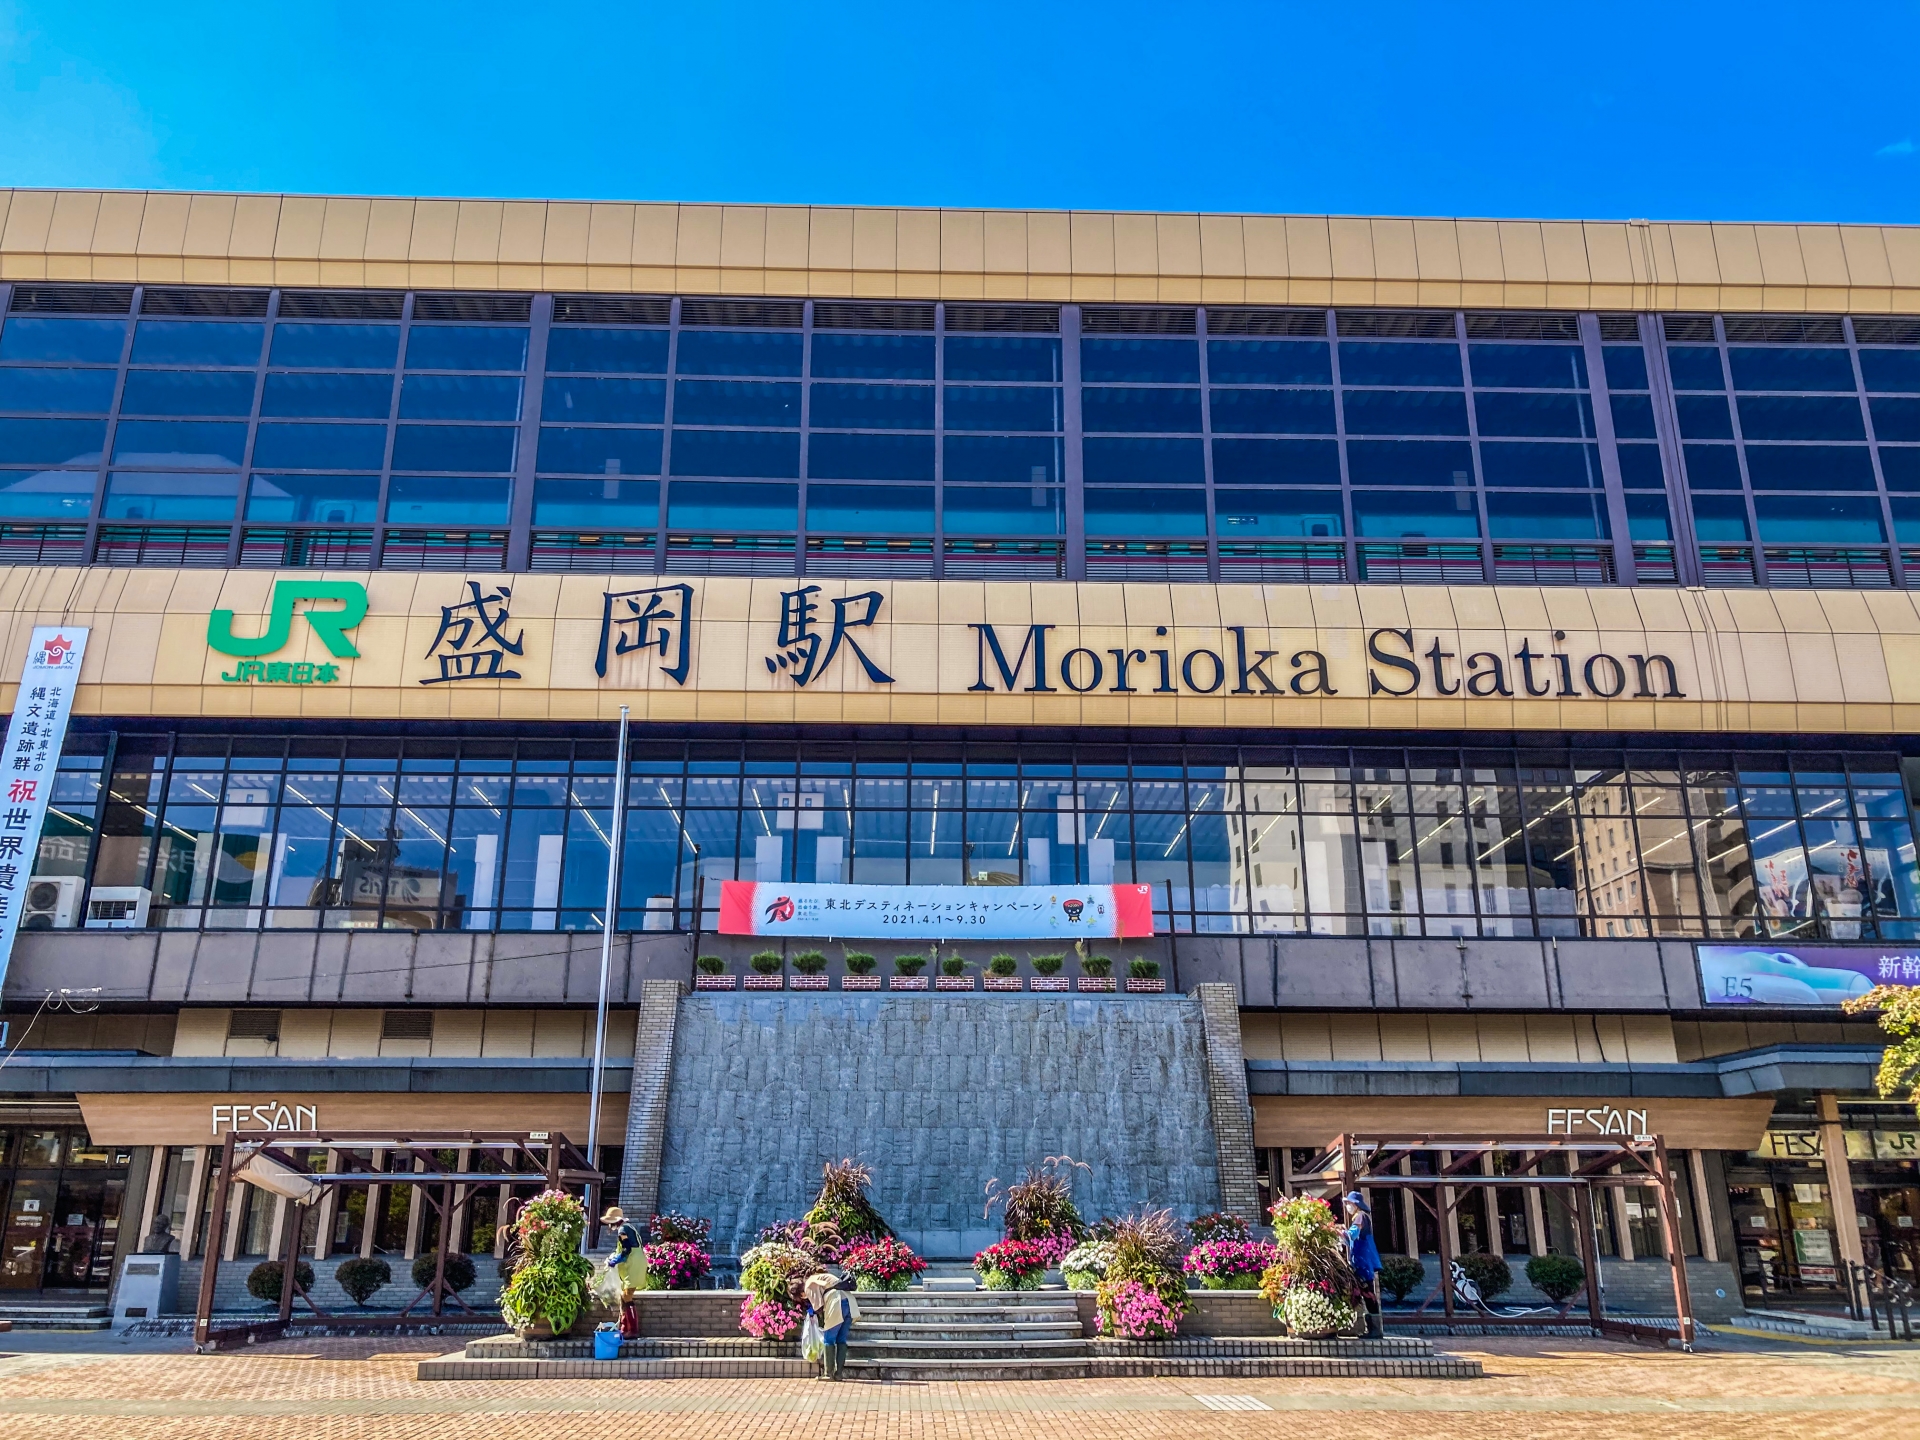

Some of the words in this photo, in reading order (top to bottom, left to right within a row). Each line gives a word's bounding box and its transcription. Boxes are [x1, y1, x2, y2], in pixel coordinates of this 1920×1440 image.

[207, 580, 369, 658] JR
[418, 580, 896, 688] 盛岡駅
[221, 661, 340, 684] JR東日本
[967, 624, 1338, 699] Morioka
[1368, 628, 1687, 700] Station
[825, 898, 1043, 911] 東北デスティネーションキャンペーン
[1722, 976, 1753, 997] E5
[1888, 1133, 1918, 1150] JR
